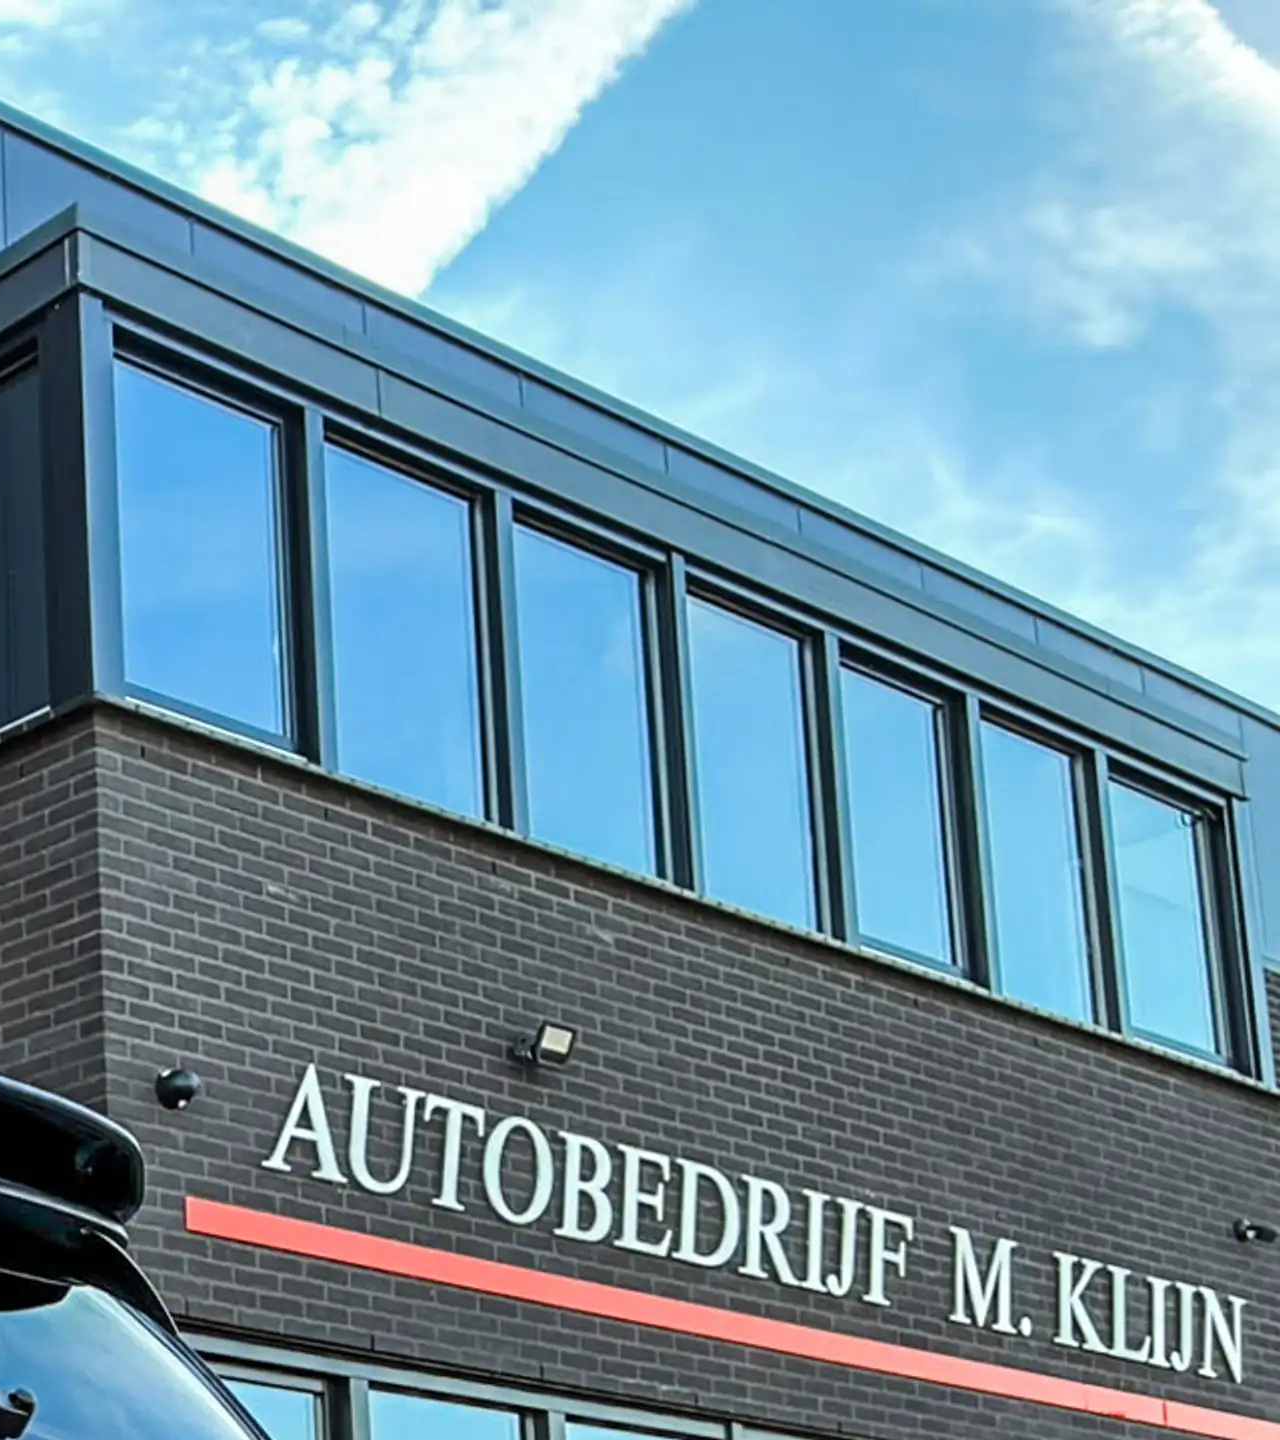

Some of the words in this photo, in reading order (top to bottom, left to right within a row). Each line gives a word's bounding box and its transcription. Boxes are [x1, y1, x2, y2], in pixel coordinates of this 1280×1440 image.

[261, 1062, 914, 1307] AUTOBEDRIJF
[948, 1225, 1032, 1337] M.
[1052, 1250, 1249, 1385] KLIJN
